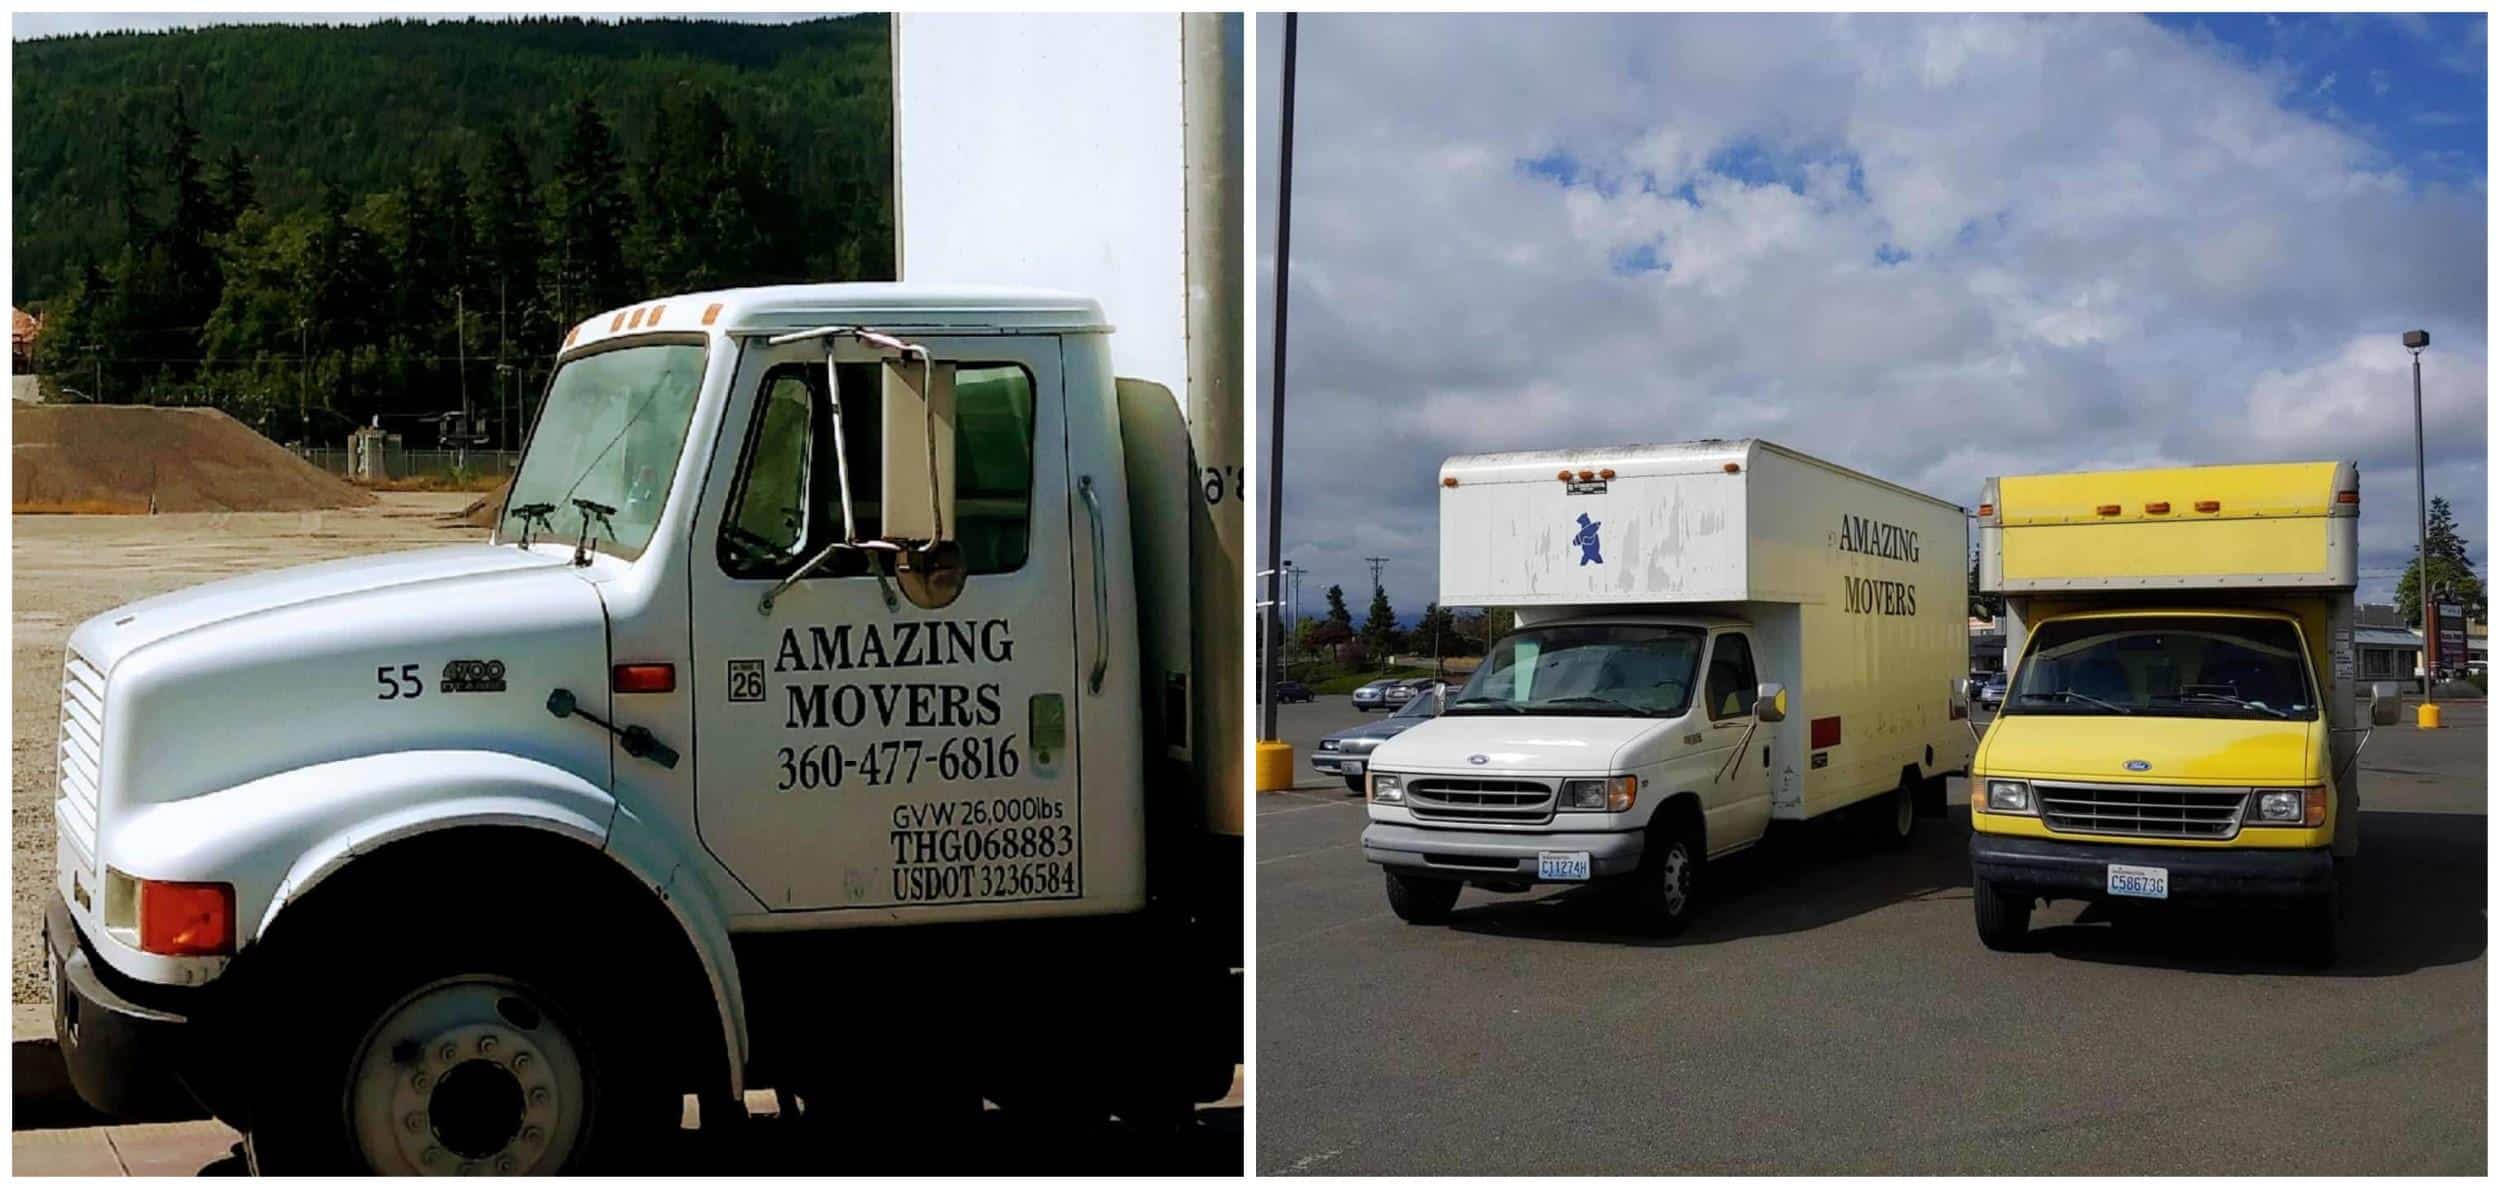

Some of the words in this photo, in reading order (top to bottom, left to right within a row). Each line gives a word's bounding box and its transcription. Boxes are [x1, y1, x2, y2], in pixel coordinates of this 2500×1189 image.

[1839, 513, 1920, 564] AMAZING
[1844, 575, 1917, 617] MOVERS
[774, 619, 1014, 673] AMAZING
[377, 663, 424, 700] 55
[733, 671, 762, 697] 26
[785, 683, 1002, 729] MOVERS
[777, 734, 1019, 791] 360-477-6816
[893, 803, 956, 829] GVW
[961, 796, 1064, 826] 26,000lbs
[890, 824, 1074, 866] THG068883
[892, 865, 976, 901] USDOT
[980, 861, 1075, 897] 3236584
[2111, 874, 2164, 894] C58673G
